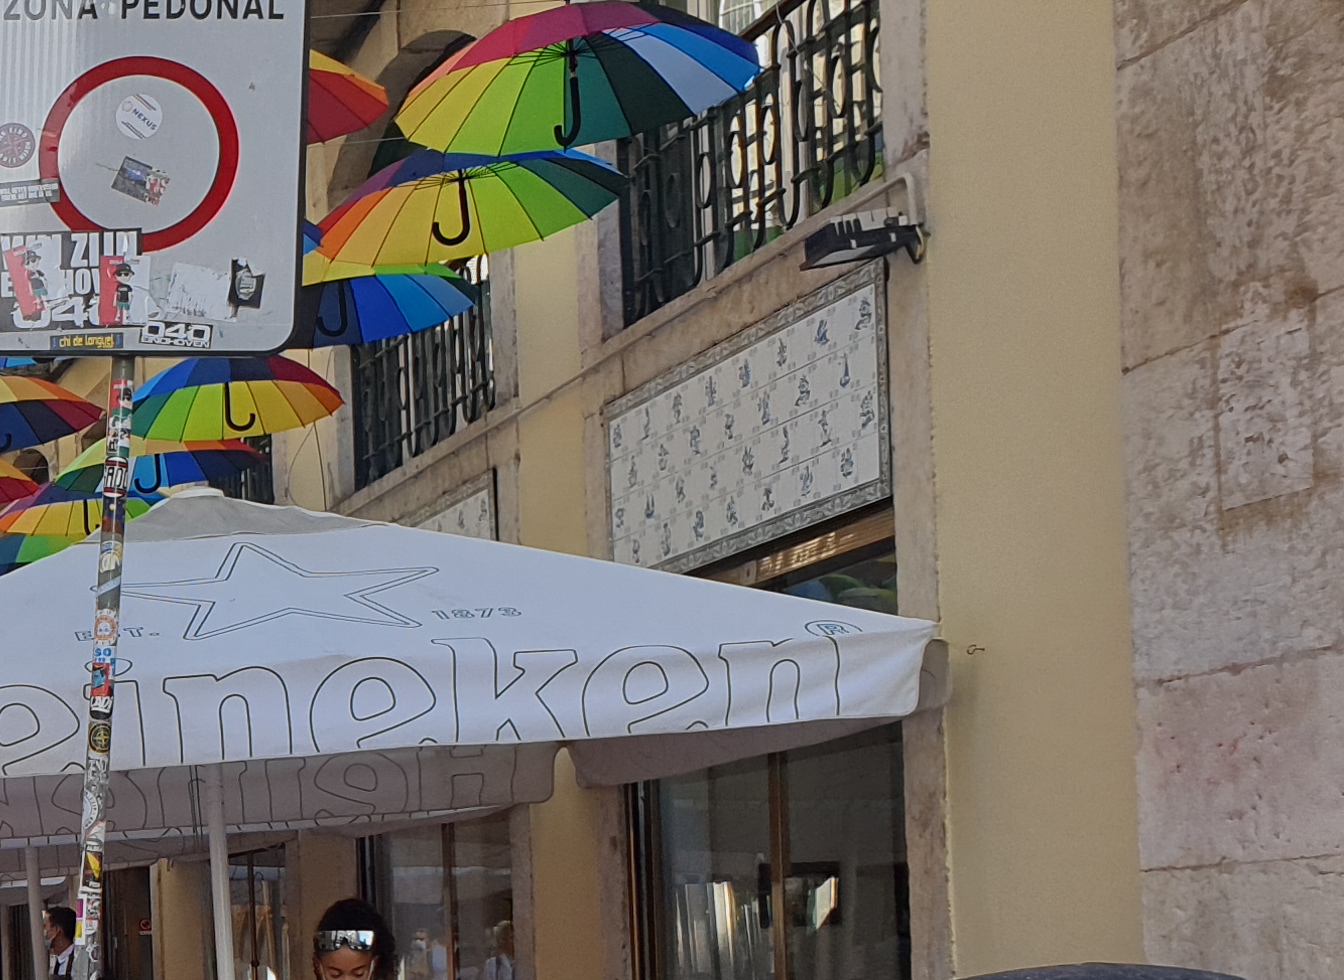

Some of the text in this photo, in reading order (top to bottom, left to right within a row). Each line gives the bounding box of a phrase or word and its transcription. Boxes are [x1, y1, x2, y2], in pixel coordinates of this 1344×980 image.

[3, 0, 284, 20] ZONA PEDONAL
[131, 108, 157, 131] NEXUS
[142, 323, 211, 341] 040
[75, 625, 160, 642] ET.
